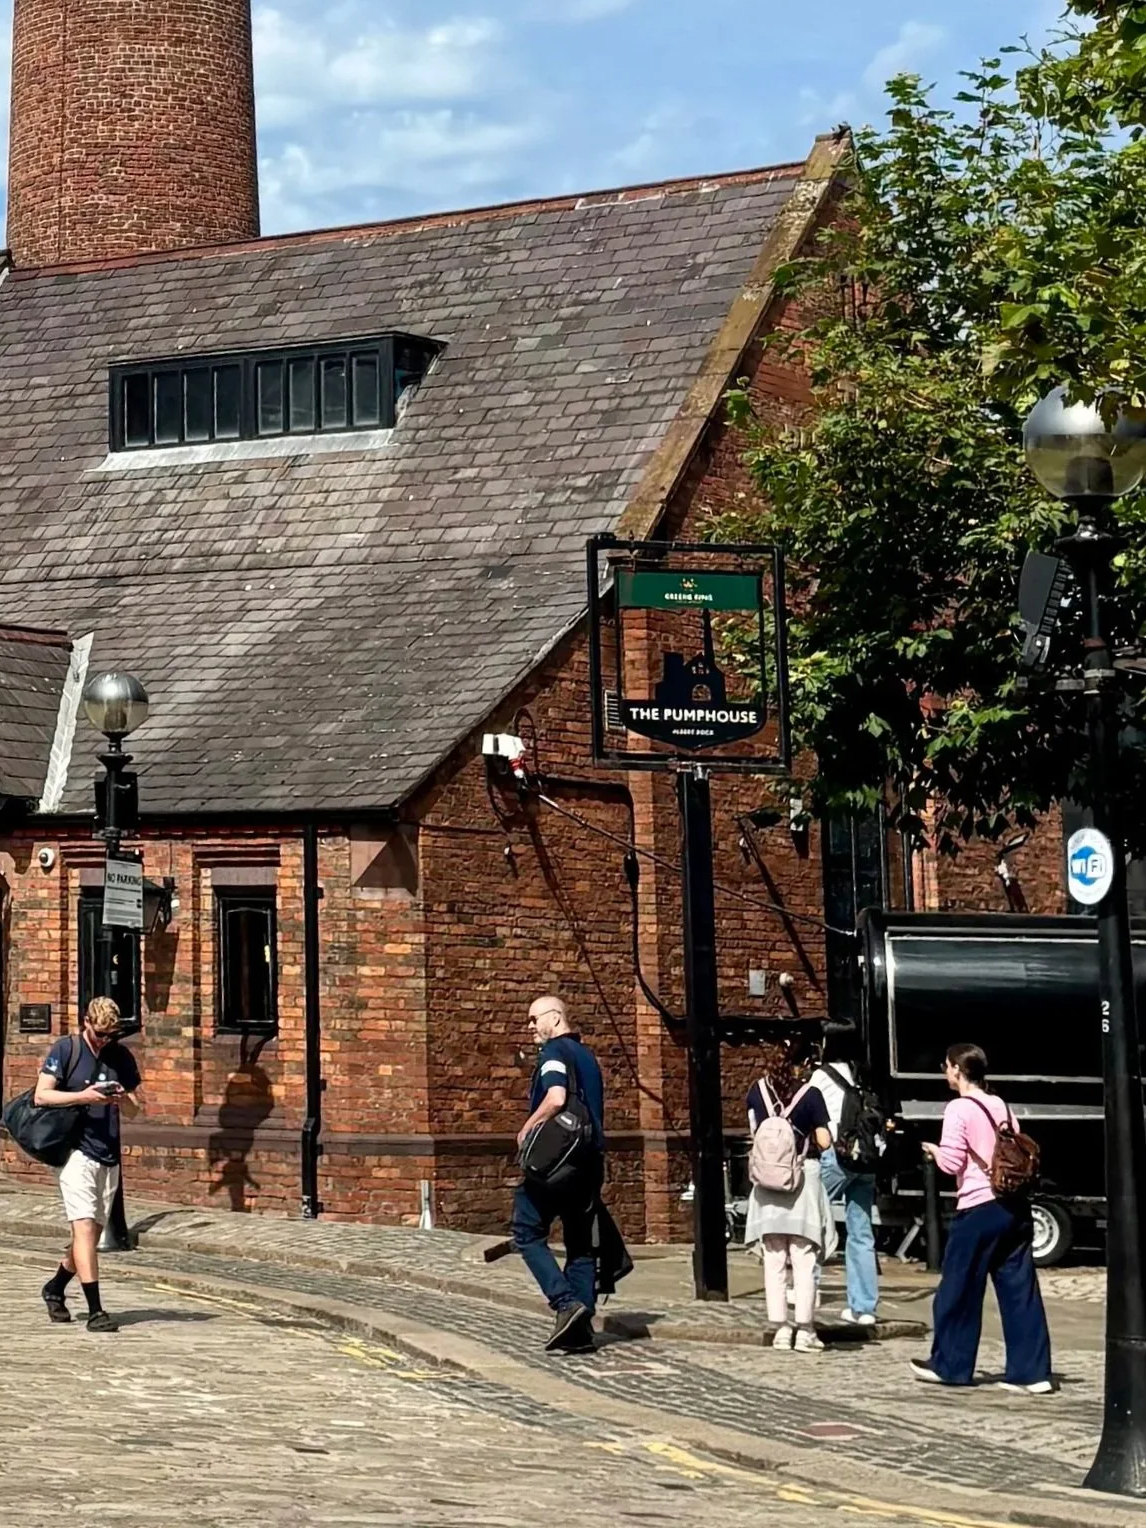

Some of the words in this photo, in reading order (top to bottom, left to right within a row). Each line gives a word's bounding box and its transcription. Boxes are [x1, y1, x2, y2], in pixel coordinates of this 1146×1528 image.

[629, 708, 660, 720] THE
[664, 709, 757, 724] PUMPHOUSE
[107, 872, 116, 883] NO
[116, 873, 142, 887] PARKING
